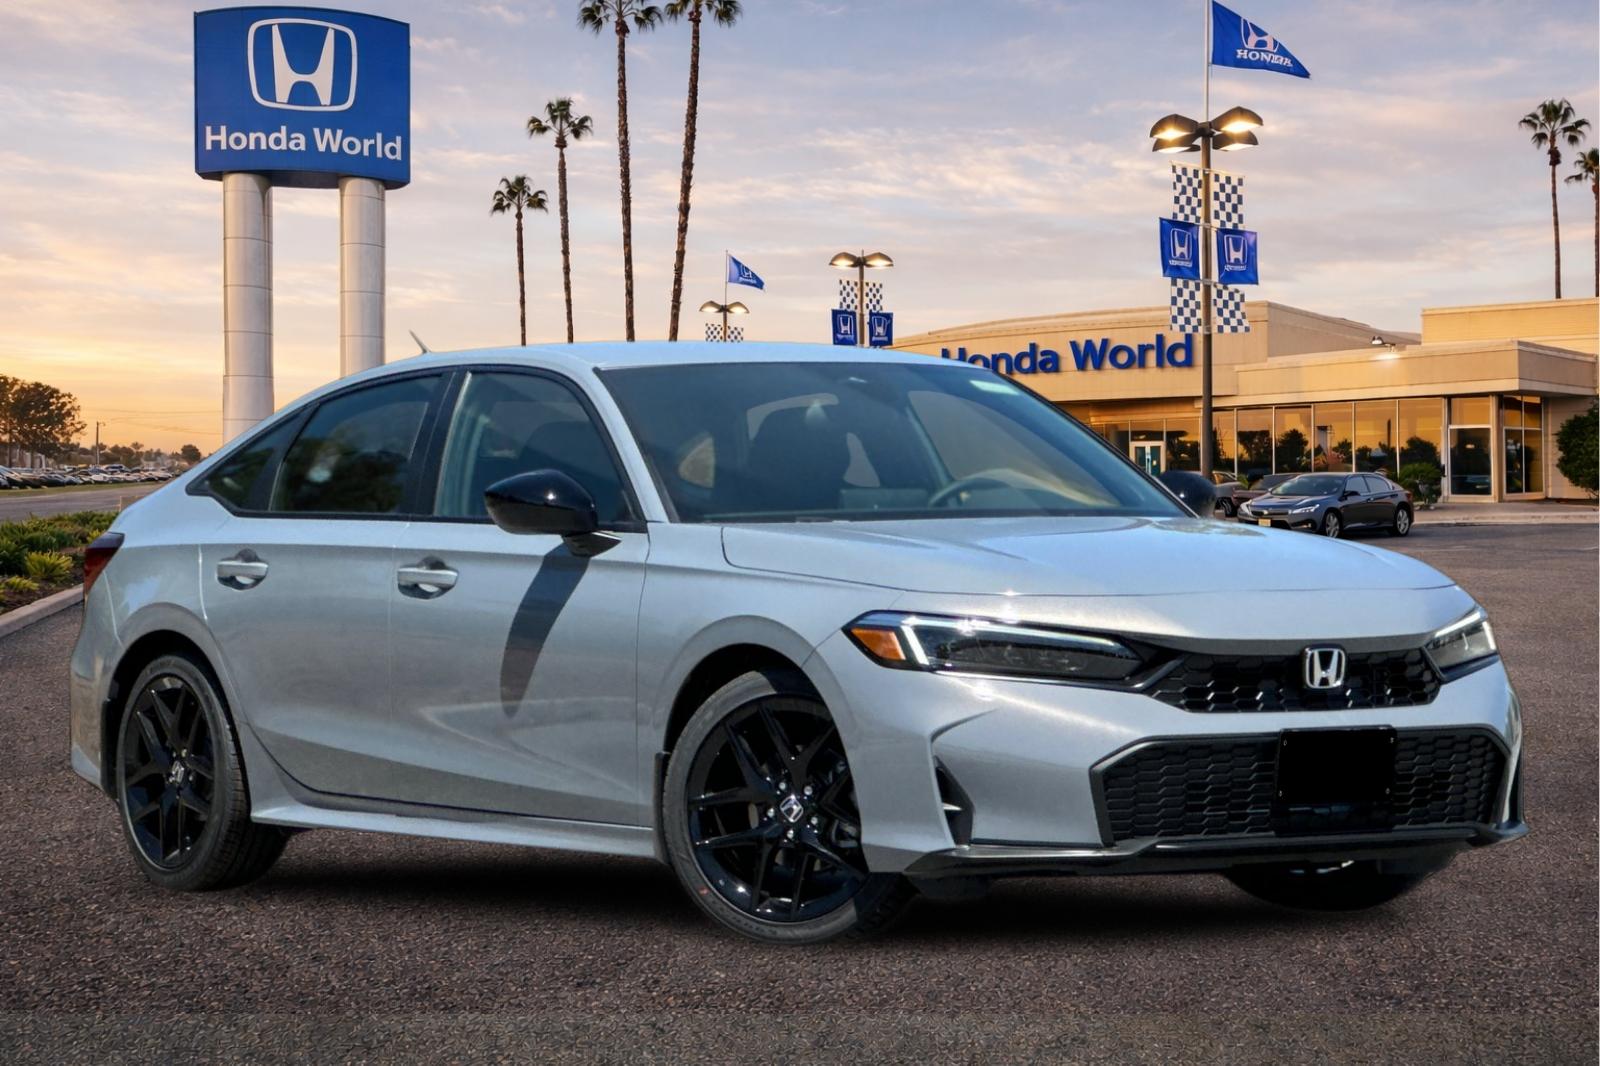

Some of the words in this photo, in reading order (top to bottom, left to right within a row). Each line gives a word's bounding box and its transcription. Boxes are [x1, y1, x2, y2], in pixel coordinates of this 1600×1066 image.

[205, 125, 306, 151] Honda
[312, 127, 402, 161] World
[1070, 333, 1194, 371] World
